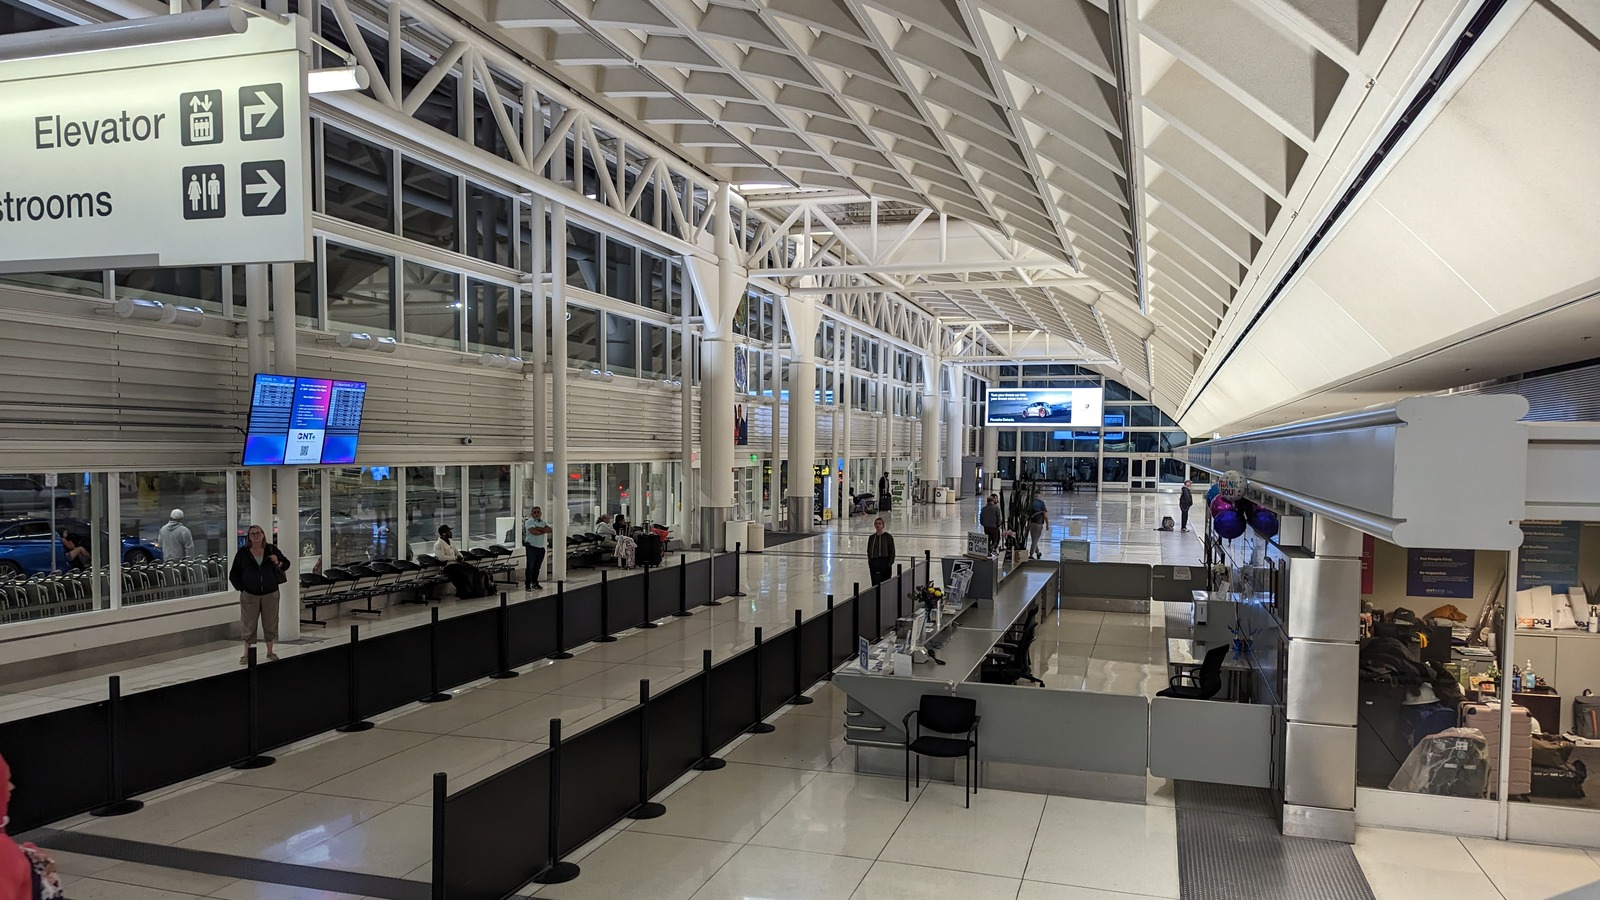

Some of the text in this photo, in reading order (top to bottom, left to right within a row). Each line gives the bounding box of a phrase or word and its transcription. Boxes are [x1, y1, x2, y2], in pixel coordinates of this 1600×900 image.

[34, 110, 165, 149] Elevator
[1219, 480, 1238, 488] THANK
[969, 533, 987, 545] Baggage
[975, 544, 987, 554] Claim
[1518, 617, 1552, 628] FedEx
